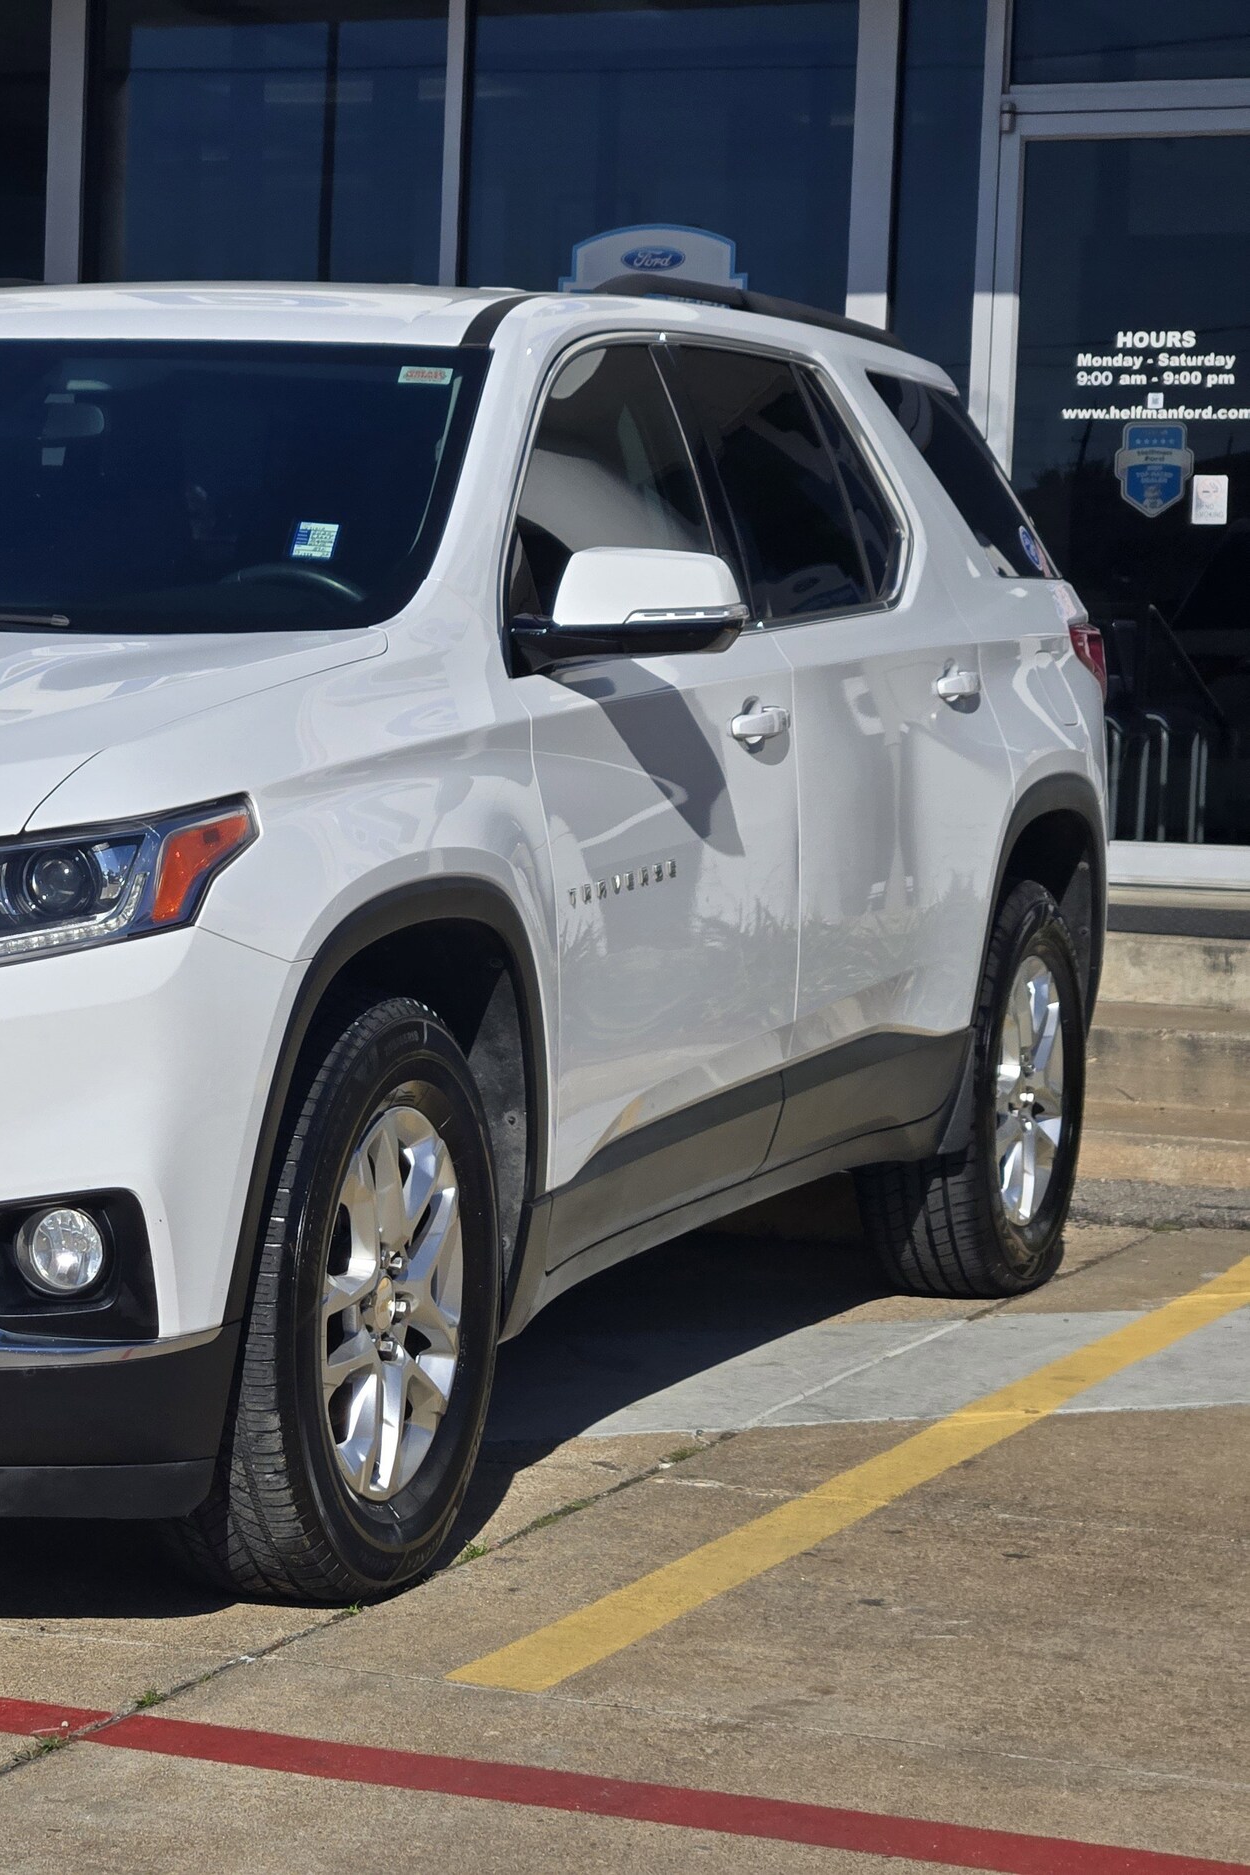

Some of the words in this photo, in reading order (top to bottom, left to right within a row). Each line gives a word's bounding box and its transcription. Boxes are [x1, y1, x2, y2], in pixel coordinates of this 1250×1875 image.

[633, 250, 672, 267] Ford
[1116, 330, 1197, 348] HOURS
[1076, 353, 1143, 369] Monday
[1157, 353, 1236, 369] Saturday
[1076, 371, 1113, 386] 9:00
[1119, 373, 1147, 385] am
[1163, 371, 1202, 385] 9:00
[1206, 374, 1235, 388] pm
[1062, 405, 1250, 420] www.helfmanford.com
